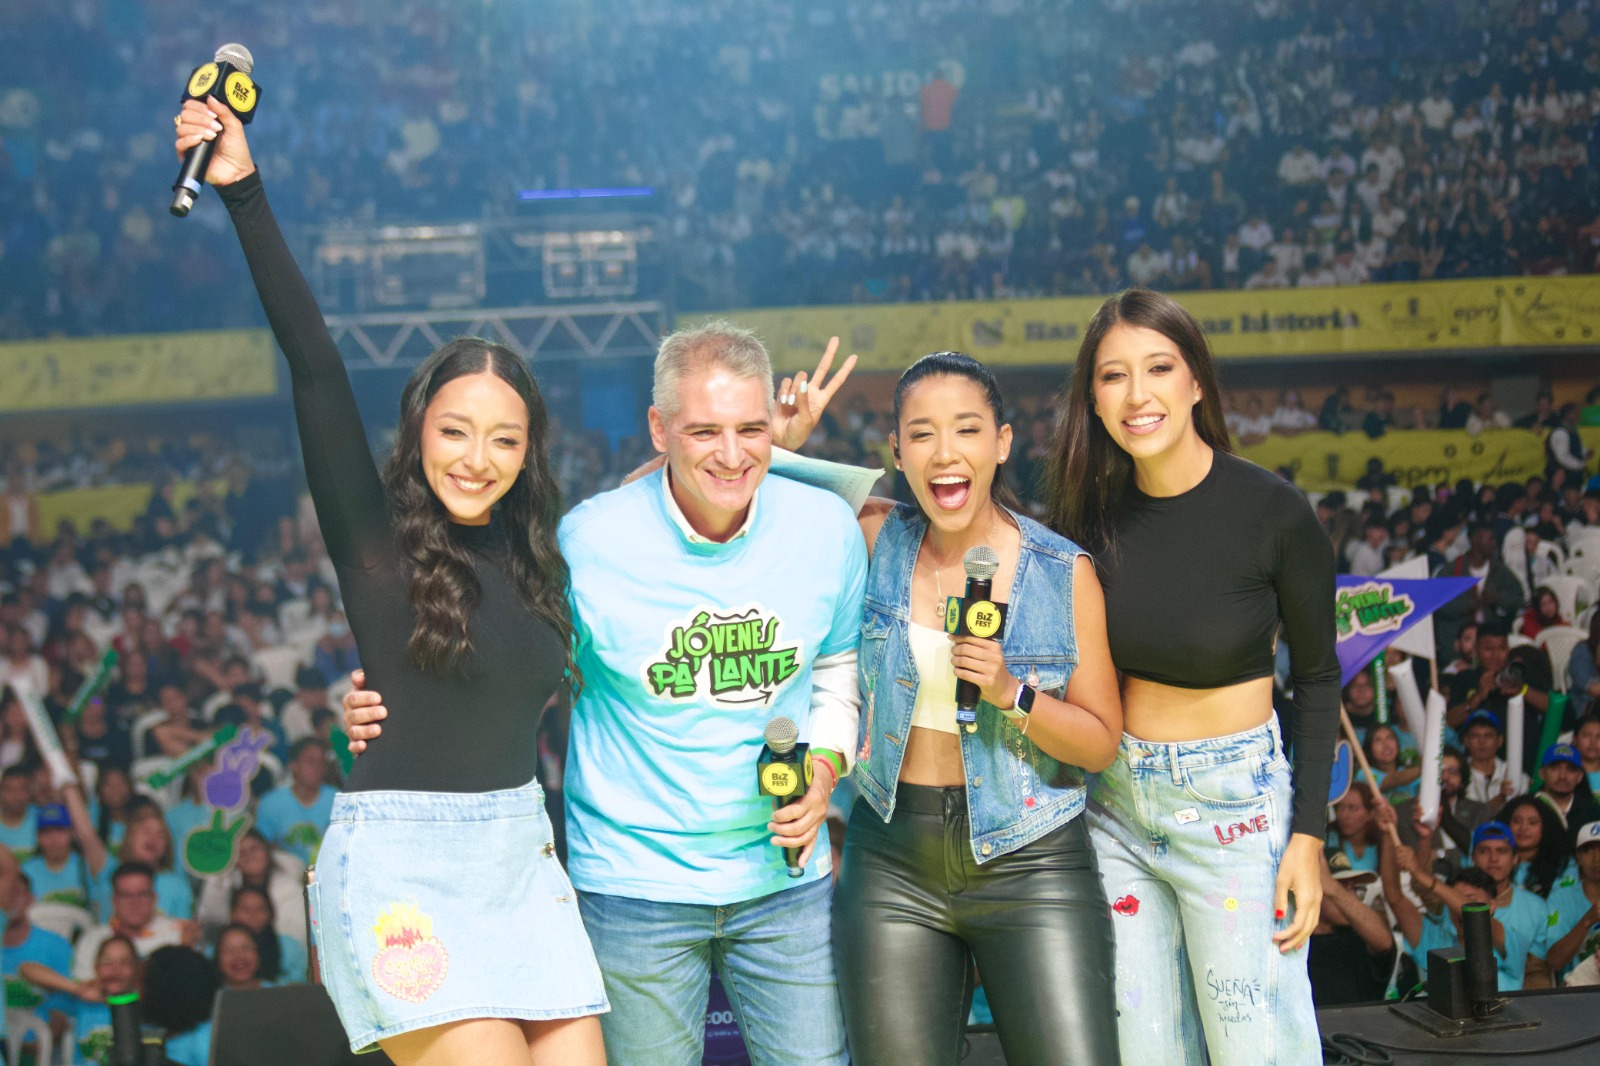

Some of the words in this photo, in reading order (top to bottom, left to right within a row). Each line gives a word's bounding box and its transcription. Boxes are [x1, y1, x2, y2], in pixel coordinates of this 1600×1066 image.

[232, 90, 247, 103] FEST
[975, 620, 992, 628] FEST
[666, 611, 779, 663] JÓVENES
[1214, 814, 1269, 845] LOVE
